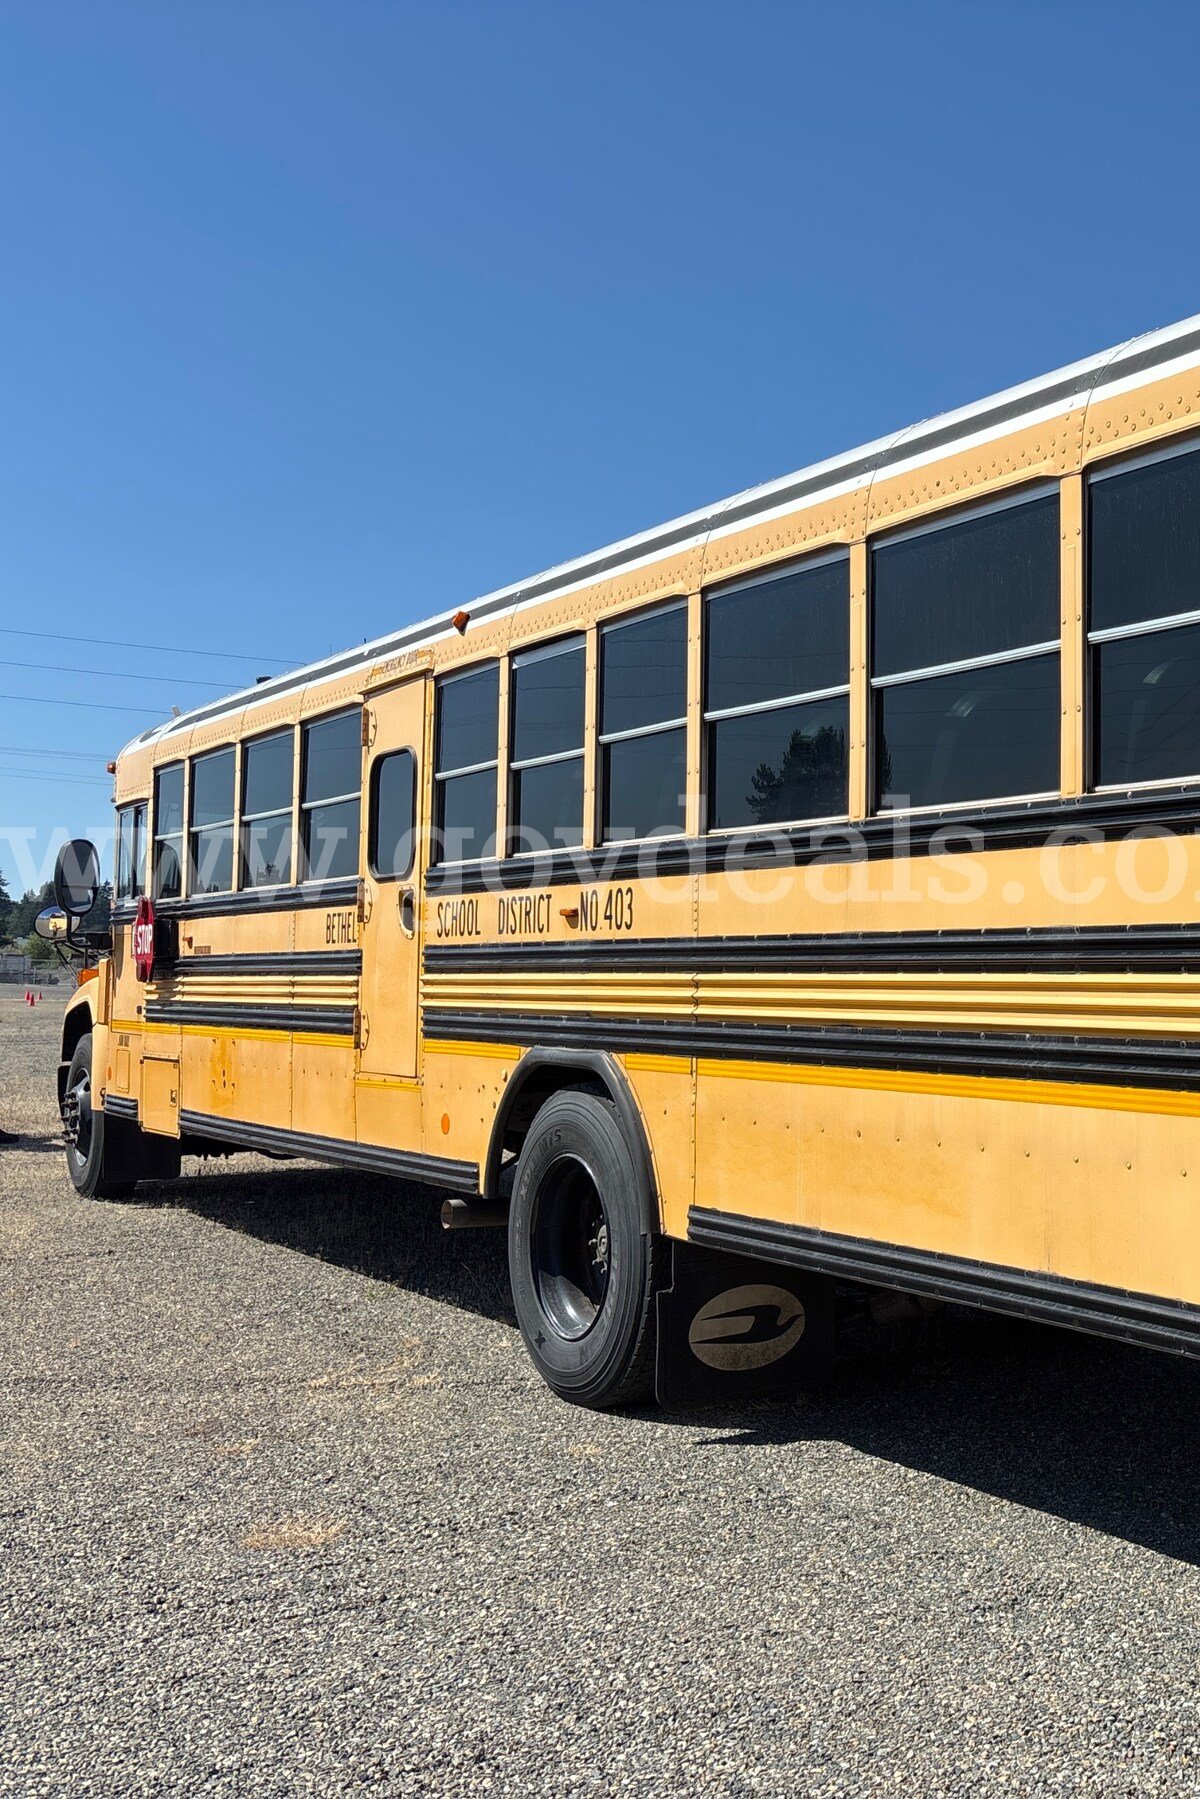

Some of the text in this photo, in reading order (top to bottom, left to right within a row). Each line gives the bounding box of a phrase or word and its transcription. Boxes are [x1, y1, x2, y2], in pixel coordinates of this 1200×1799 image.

[136, 923, 153, 955] STOP
[326, 911, 358, 944] BETHEL
[437, 899, 481, 937] SCHOOL
[498, 893, 553, 935] DISTRICT
